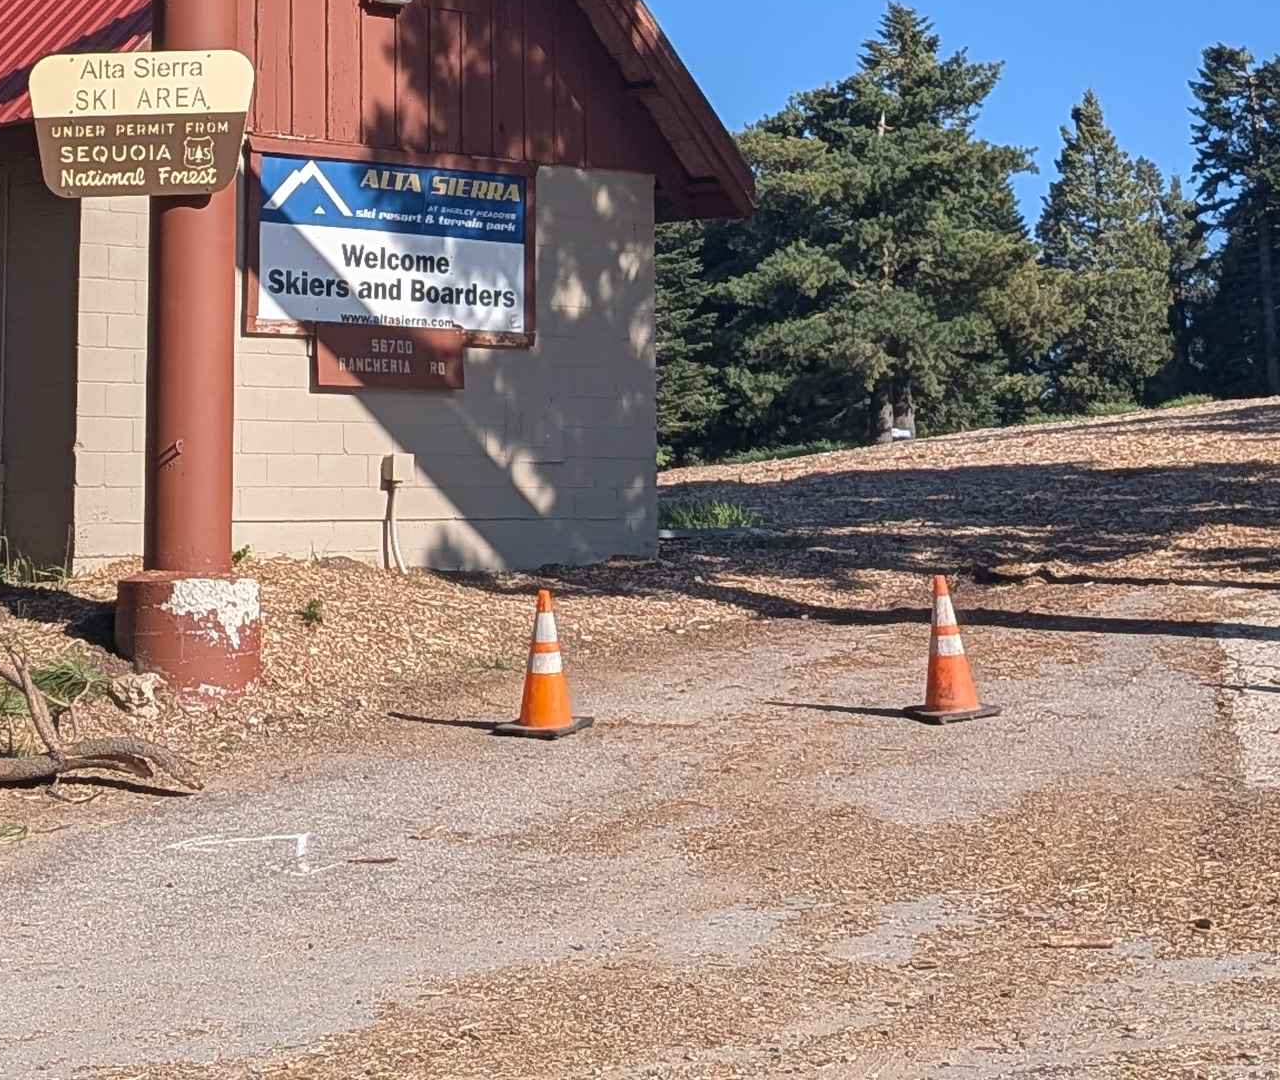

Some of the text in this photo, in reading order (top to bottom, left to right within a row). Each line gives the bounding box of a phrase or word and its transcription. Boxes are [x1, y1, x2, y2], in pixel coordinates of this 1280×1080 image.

[80, 57, 203, 80] Alta Sierra
[75, 86, 207, 111] SKI AREA
[51, 121, 229, 138] UNDER PERMIT FROM
[60, 144, 172, 164] SEQUOIA
[61, 166, 217, 188] National Forest
[360, 168, 521, 203] ALTA SIERRA
[355, 207, 377, 219] ski
[378, 211, 422, 223] resort
[438, 216, 484, 229] terrain
[486, 222, 516, 232] park
[341, 243, 451, 275] Welcome
[268, 268, 516, 308] Skiers and Boarders
[340, 312, 455, 328] www.altasierra.com
[338, 356, 411, 374] RANCHERIA
